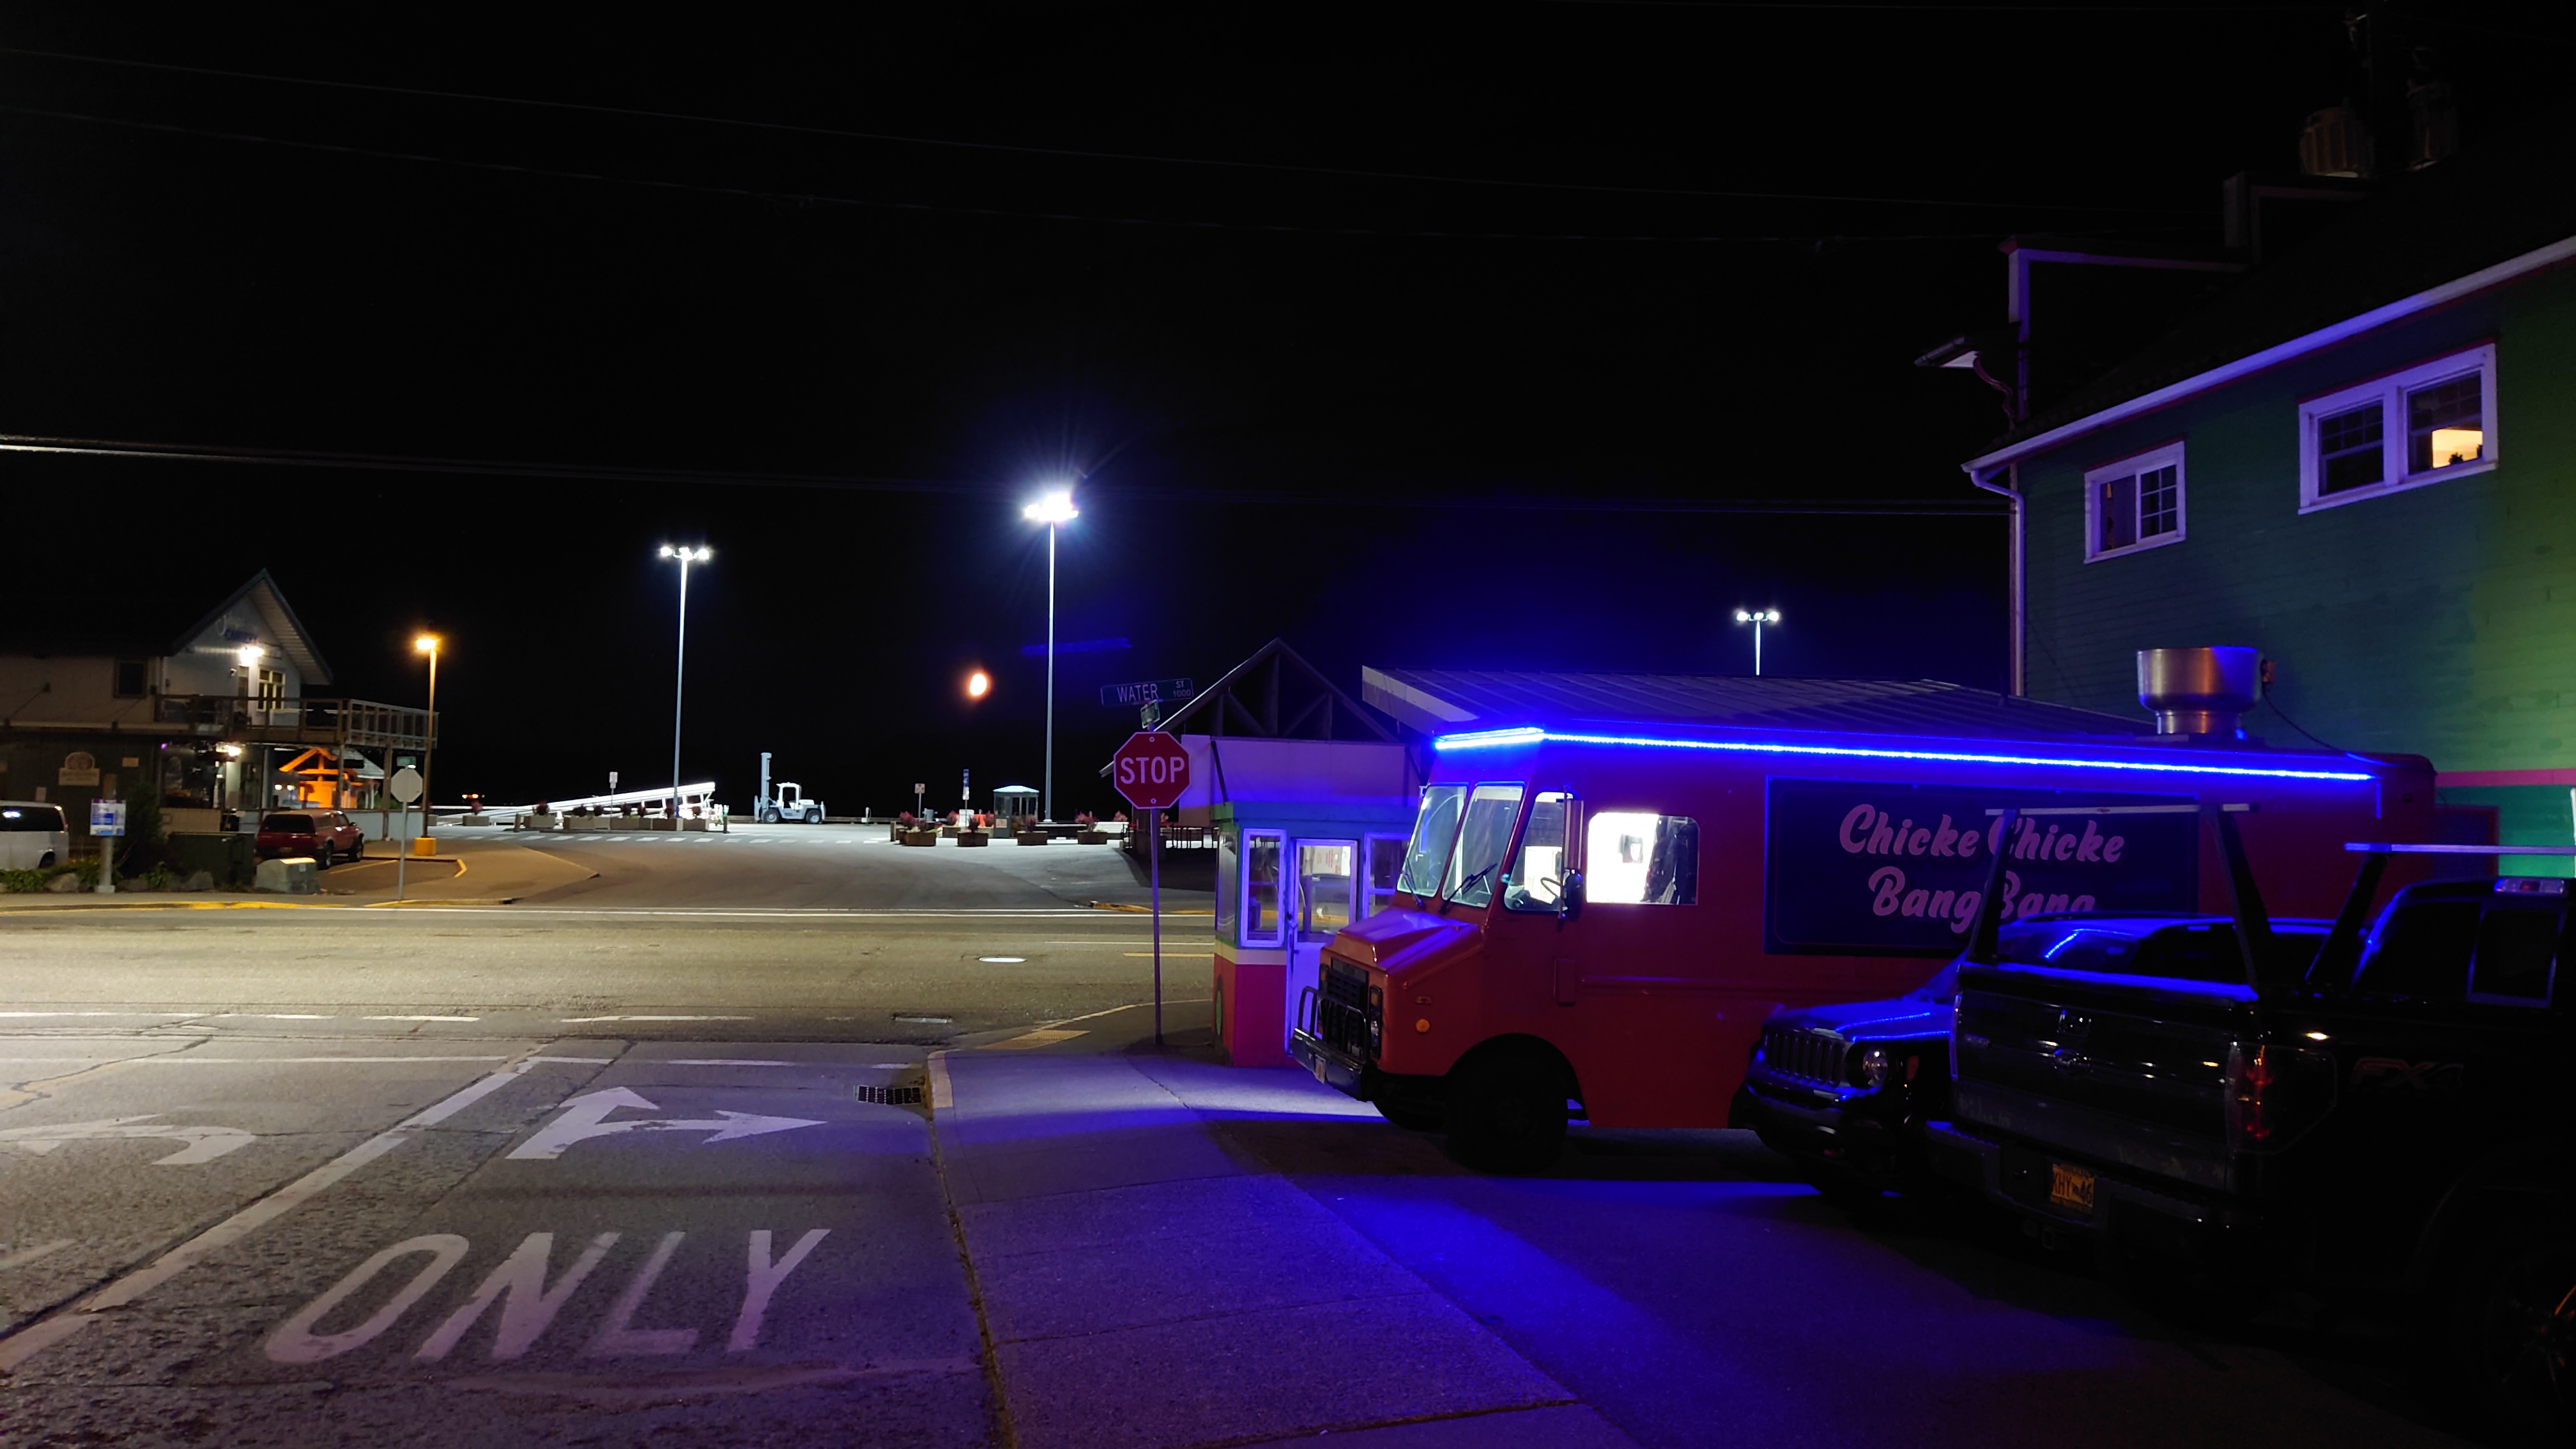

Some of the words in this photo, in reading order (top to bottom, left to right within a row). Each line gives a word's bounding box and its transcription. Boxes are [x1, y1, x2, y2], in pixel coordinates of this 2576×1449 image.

[1116, 683, 1160, 702] WATER
[1176, 680, 1185, 689] ST
[1173, 689, 1191, 698] 1000
[1120, 756, 1185, 784] STOP
[1839, 804, 1980, 857] Chicke
[1868, 866, 1982, 934] Bang
[2349, 1056, 2465, 1090] FX4
[264, 1229, 831, 1364] ONLY
